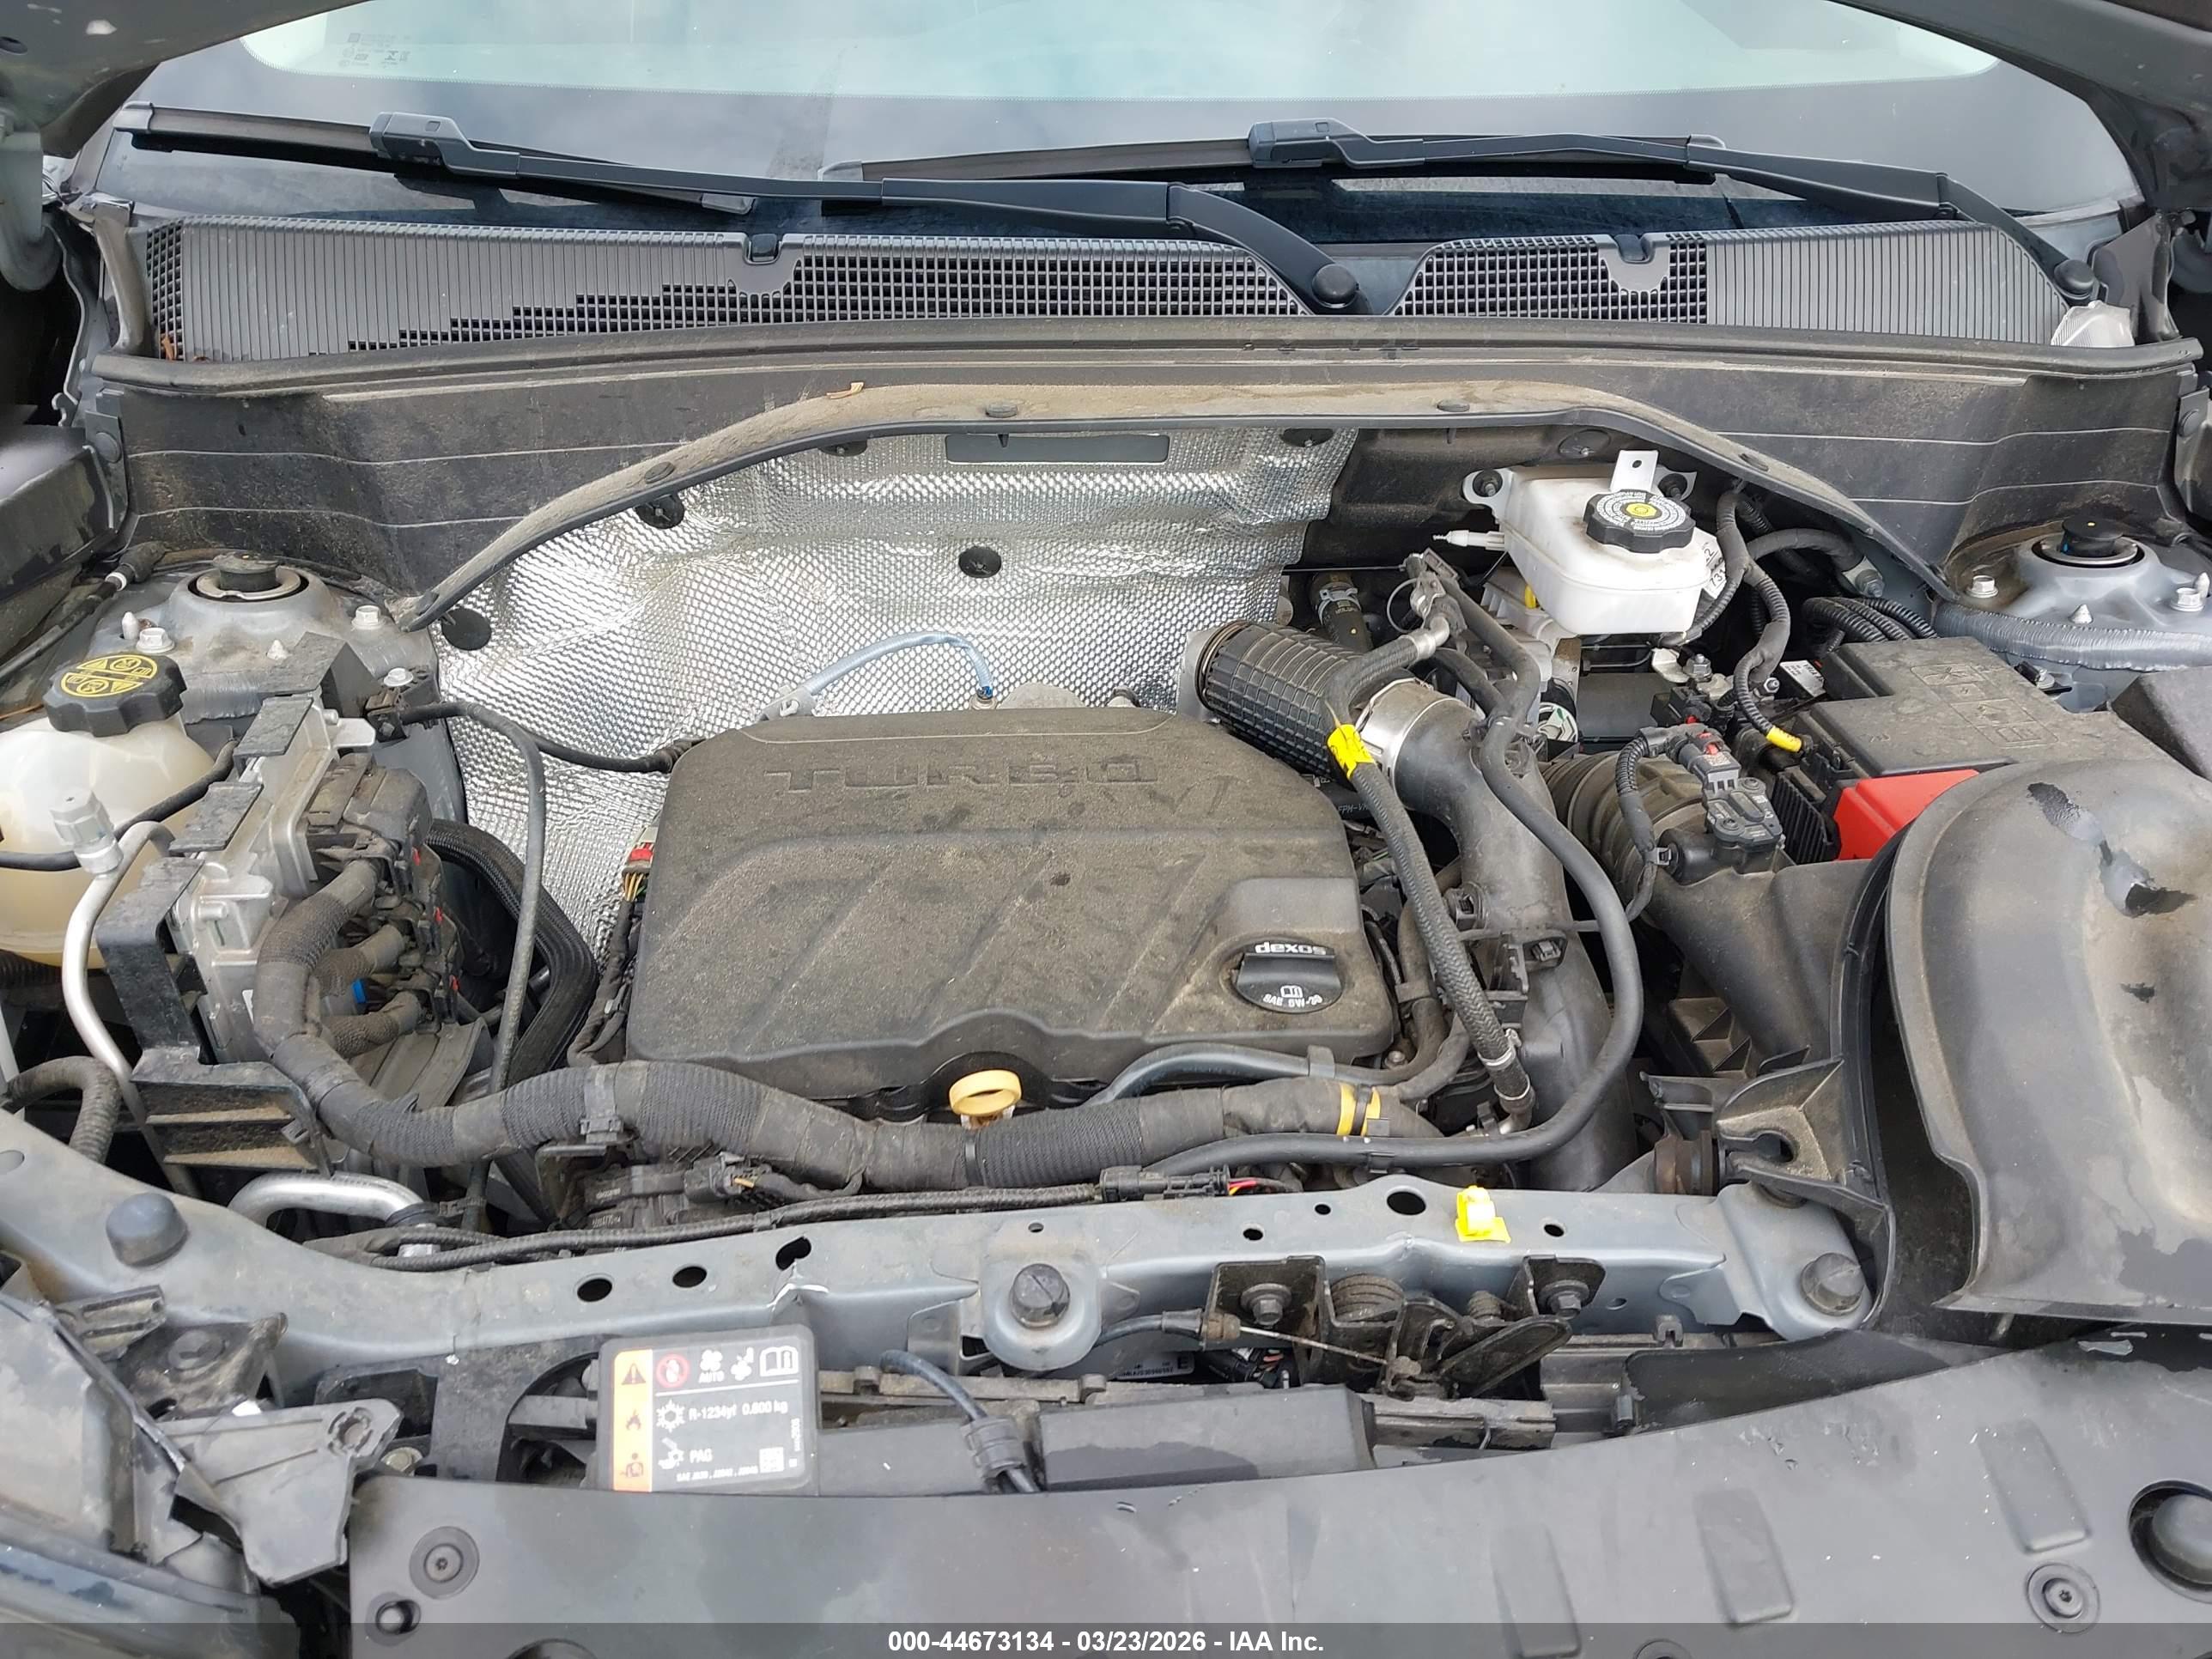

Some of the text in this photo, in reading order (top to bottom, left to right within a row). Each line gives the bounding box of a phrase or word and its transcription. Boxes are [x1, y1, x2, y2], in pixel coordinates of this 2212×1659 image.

[764, 760, 1159, 793] TURBO
[1255, 942, 1326, 955] dexos
[698, 1371, 725, 1383] AUTO
[689, 1403, 738, 1421] R-1234yf
[773, 1399, 788, 1414] kg
[690, 1449, 713, 1463] PAG
